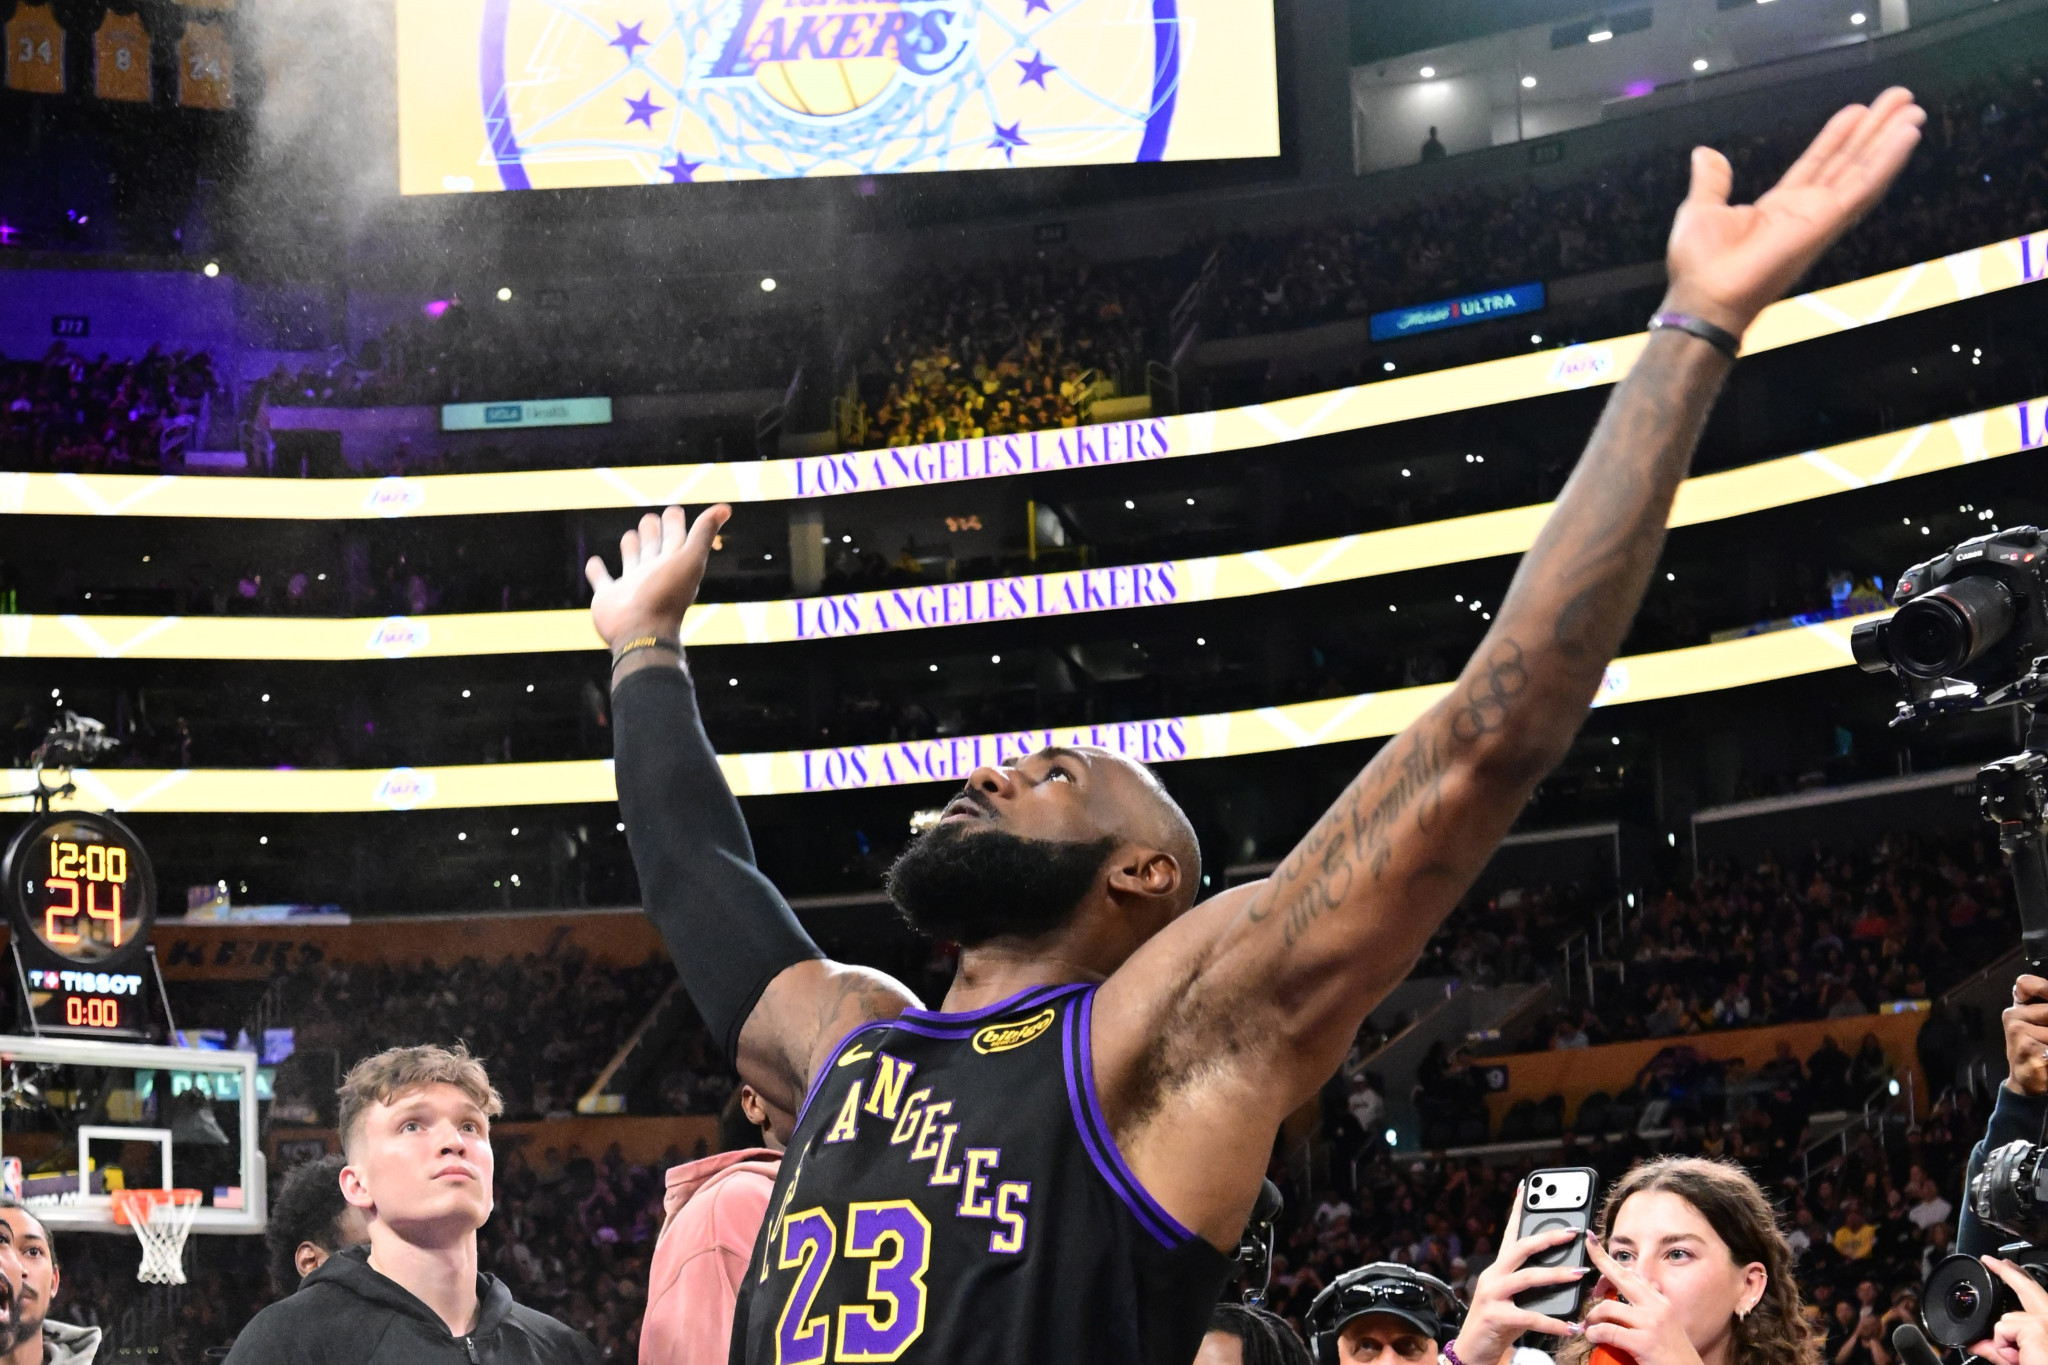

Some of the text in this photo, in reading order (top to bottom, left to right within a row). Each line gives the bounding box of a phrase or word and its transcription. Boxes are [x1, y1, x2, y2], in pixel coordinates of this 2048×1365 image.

[19, 37, 51, 64] 34
[116, 48, 131, 71] 8
[700, 0, 968, 77] LAKERS
[189, 54, 221, 80] 24
[1461, 293, 1517, 316] ULTRA
[795, 416, 1170, 498] LOS ANGELES LAKERS
[795, 561, 1178, 640] LOS ANGELES LAKERS
[802, 745, 870, 792] LOS
[51, 842, 127, 883] 12:00
[45, 878, 122, 947] 24
[60, 971, 142, 995] TISSOT
[67, 997, 118, 1028] 0:00
[823, 1051, 1032, 1254] ANGELES
[775, 1199, 932, 1365] 23
